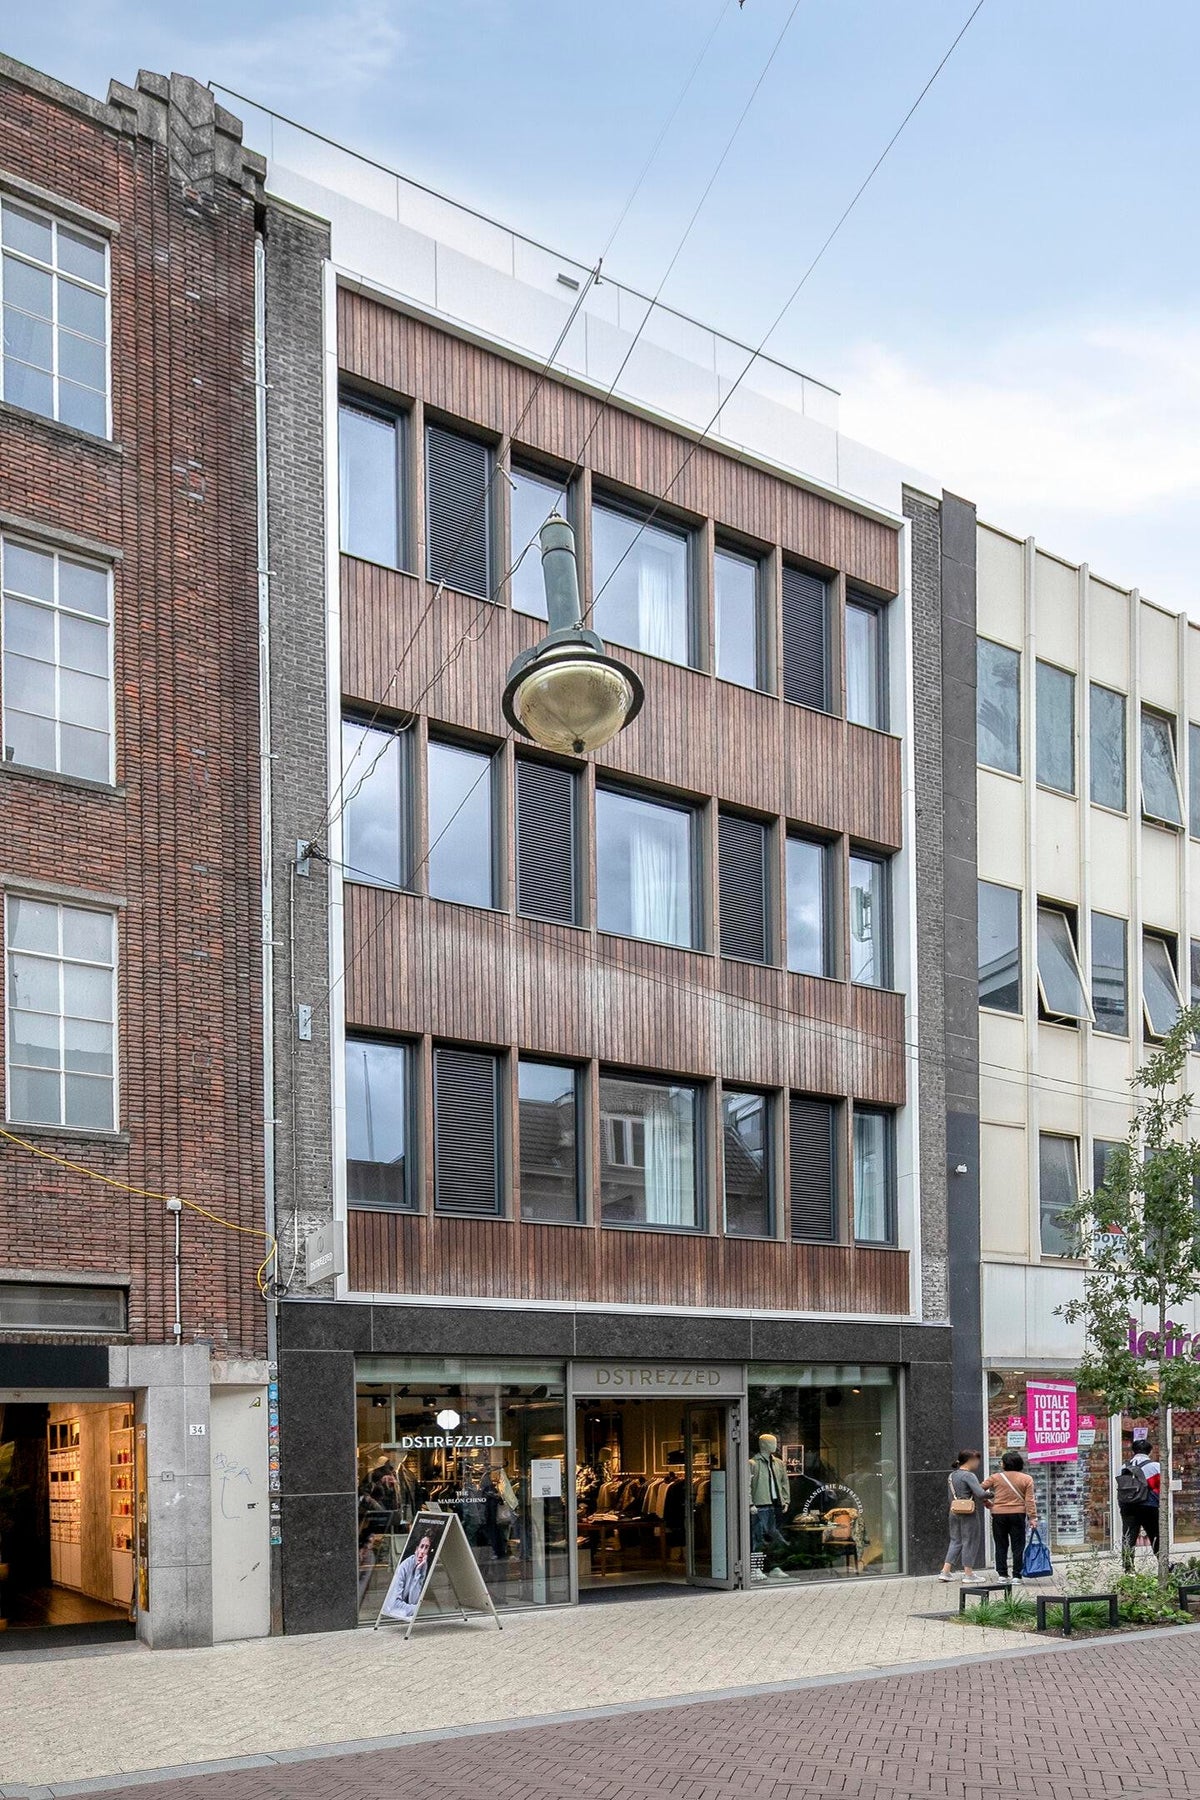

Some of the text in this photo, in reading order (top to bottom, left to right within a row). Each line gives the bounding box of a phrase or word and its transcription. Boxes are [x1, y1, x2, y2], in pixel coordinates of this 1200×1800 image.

[596, 1369, 720, 1386] DSTREZZED
[1033, 1394, 1070, 1409] TOTALE
[1034, 1409, 1070, 1432] LEEG
[191, 1425, 204, 1434] 34
[402, 1435, 495, 1448] DSTREZZED
[1034, 1431, 1071, 1444] VERKOOP
